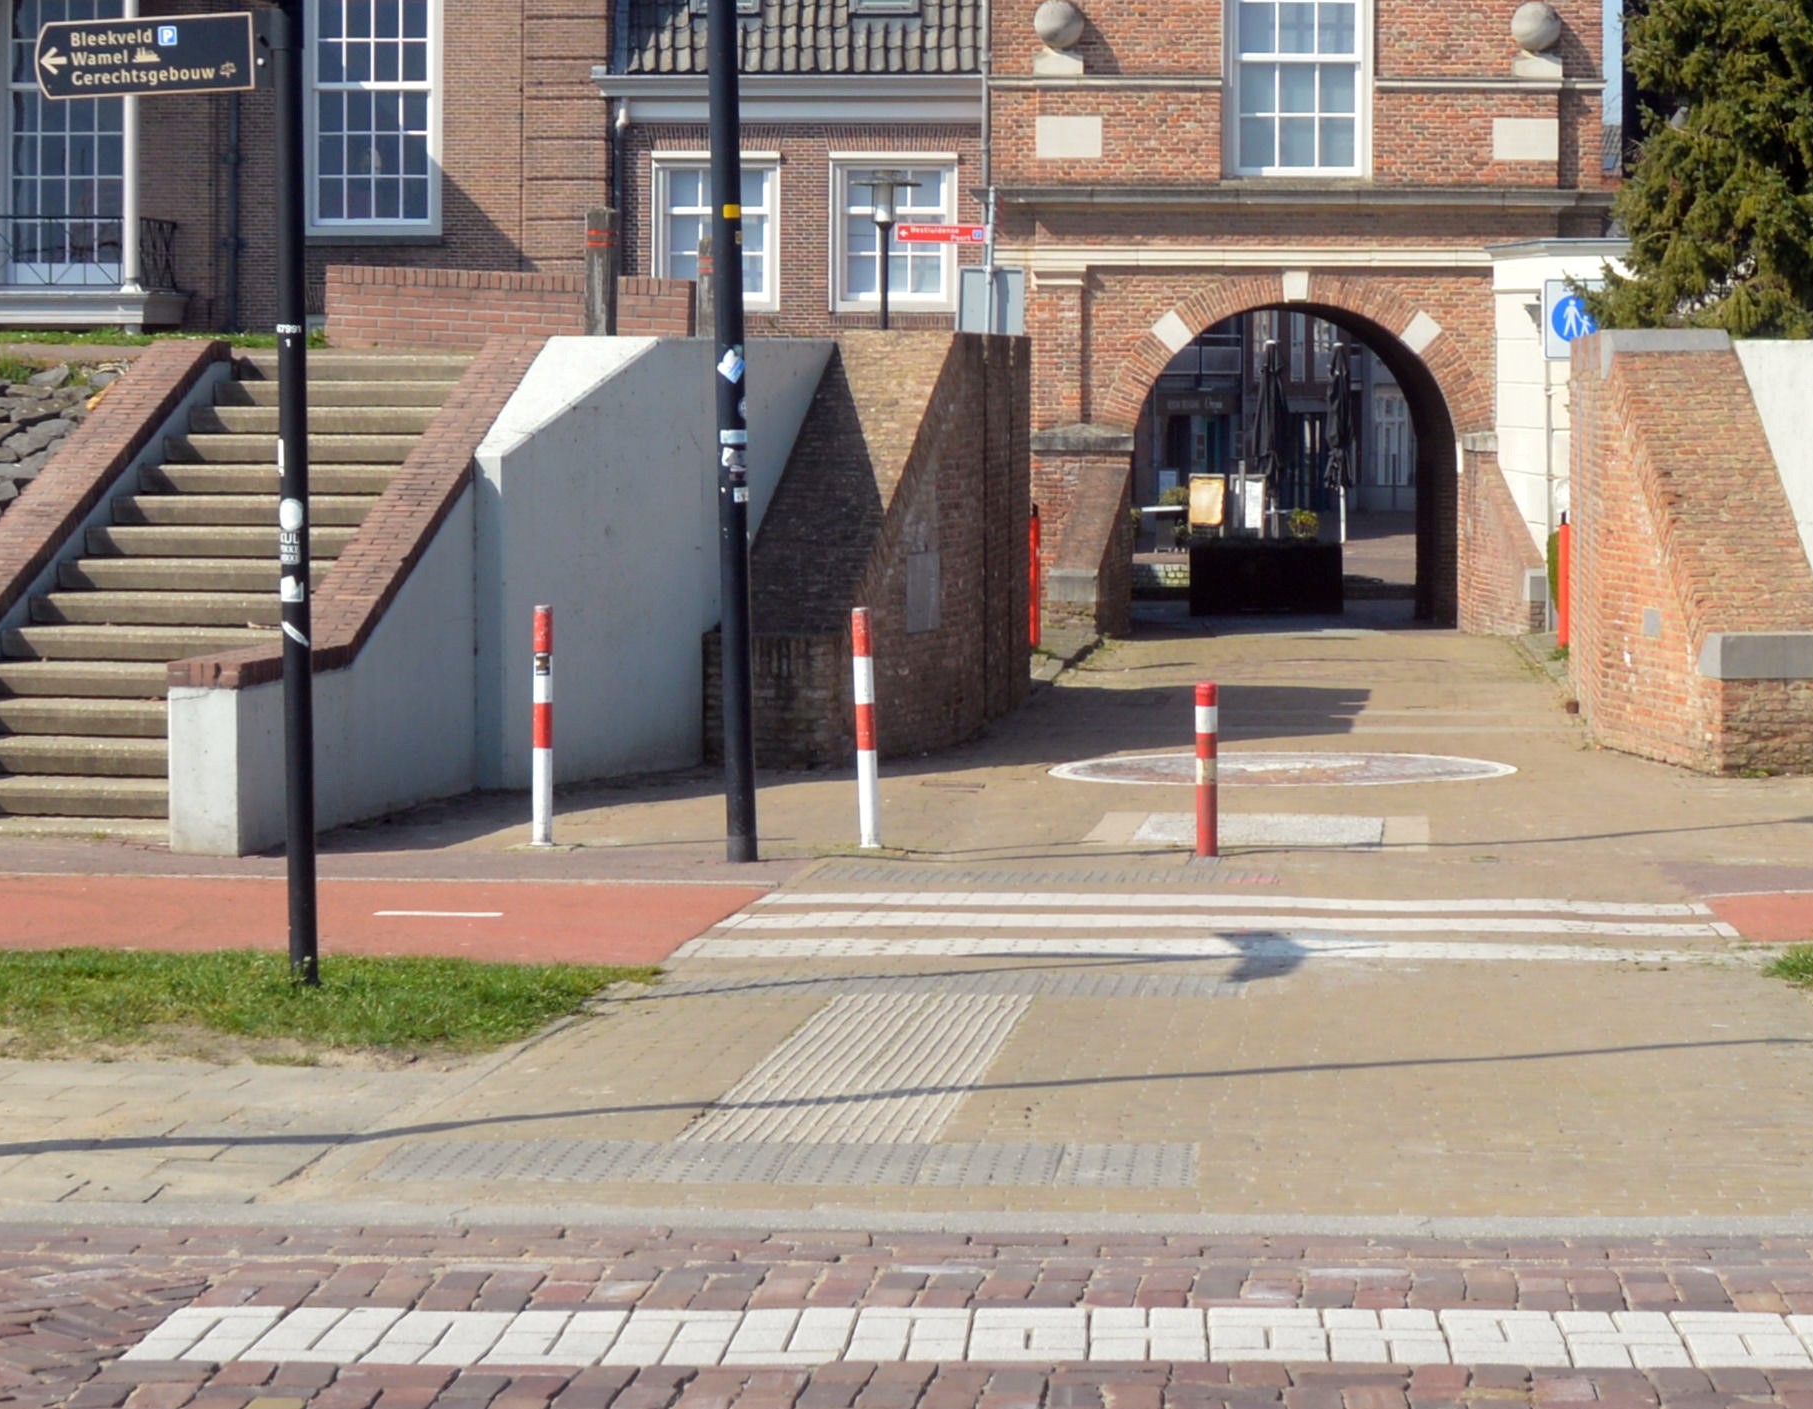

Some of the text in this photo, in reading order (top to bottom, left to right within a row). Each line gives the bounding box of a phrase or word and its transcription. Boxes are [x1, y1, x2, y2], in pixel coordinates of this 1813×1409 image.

[70, 29, 152, 47] Bleekveld
[71, 51, 128, 66] Wamel
[71, 67, 215, 85] Gerechtsgebouw
